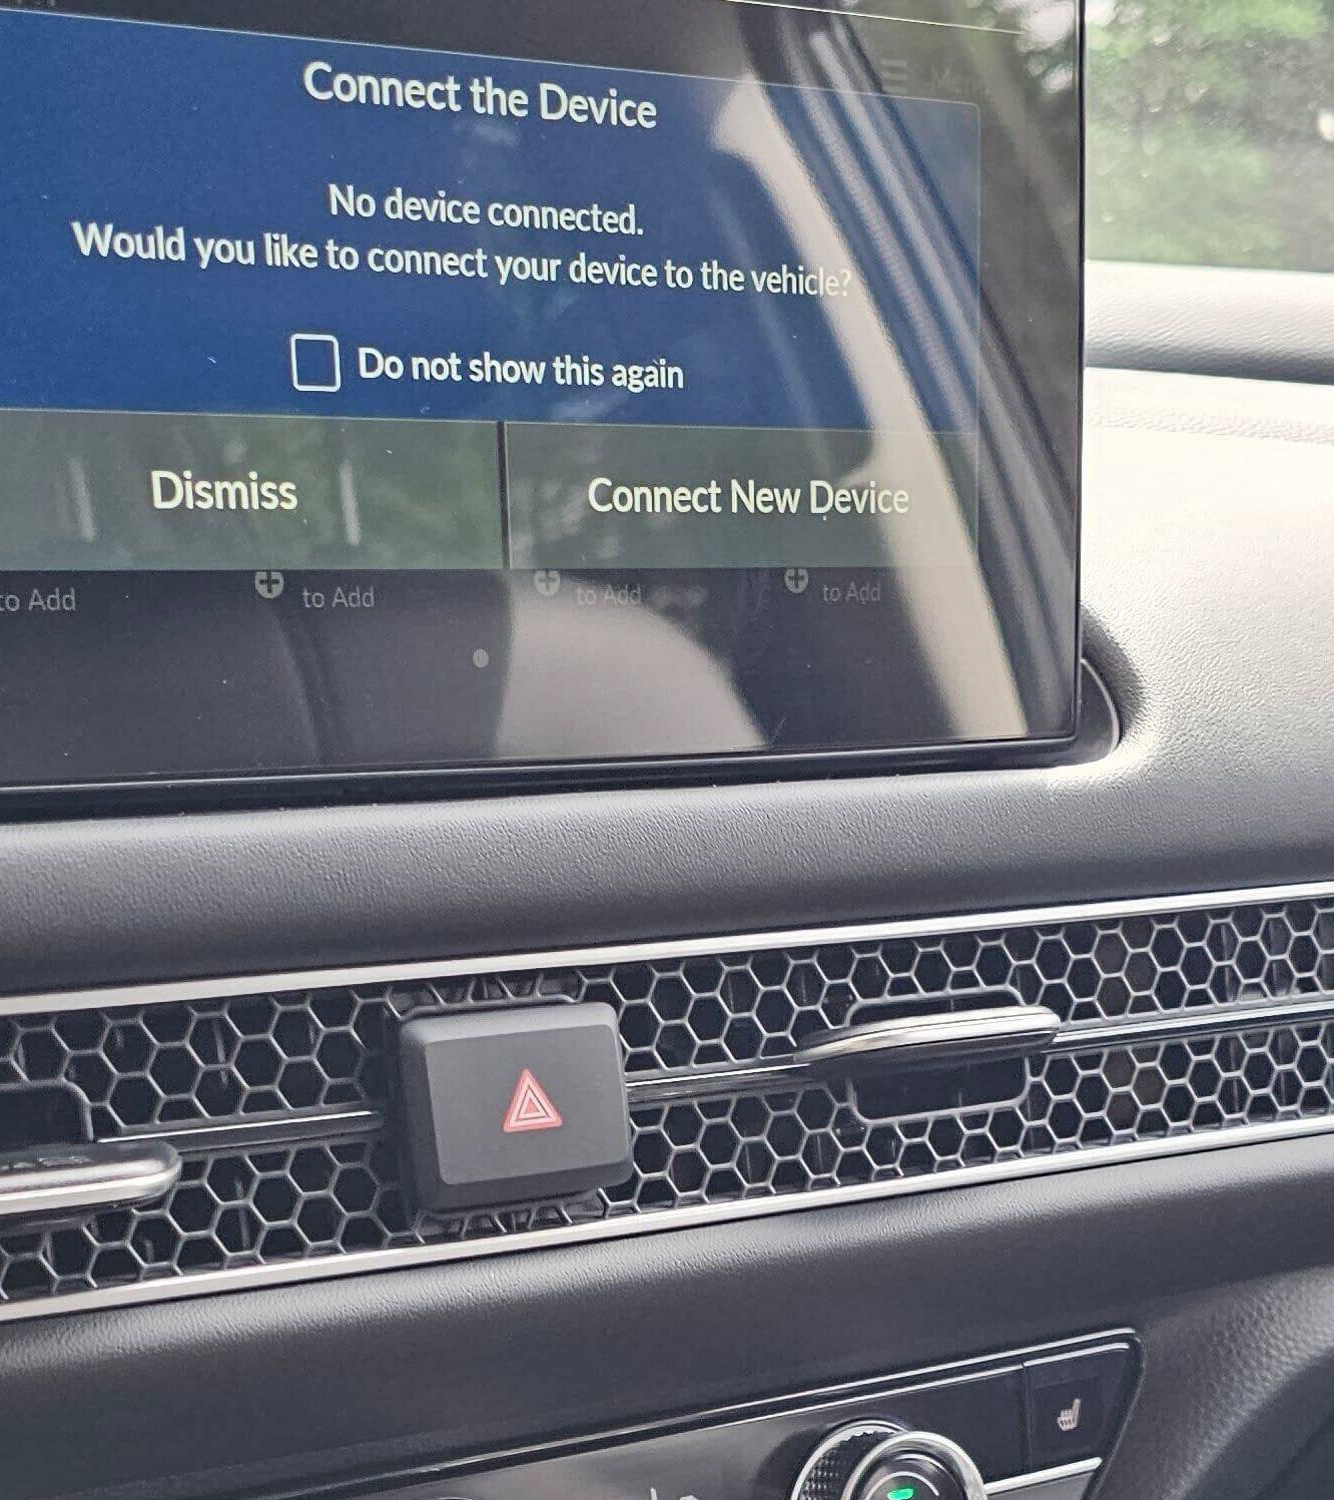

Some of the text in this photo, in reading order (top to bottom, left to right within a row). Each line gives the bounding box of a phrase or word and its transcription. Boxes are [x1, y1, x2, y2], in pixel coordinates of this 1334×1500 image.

[302, 60, 658, 129] Connect the Device
[328, 183, 644, 236] No device connected.
[71, 221, 852, 298] Would you like to connect your device to the vehicle?
[358, 346, 684, 393] Do not show this again
[151, 469, 299, 511] Dismiss
[587, 477, 910, 514] Connect New Device
[28, 587, 76, 612] Add
[302, 585, 375, 609] to Add
[576, 584, 642, 606] to Add
[823, 581, 882, 603] to Add
